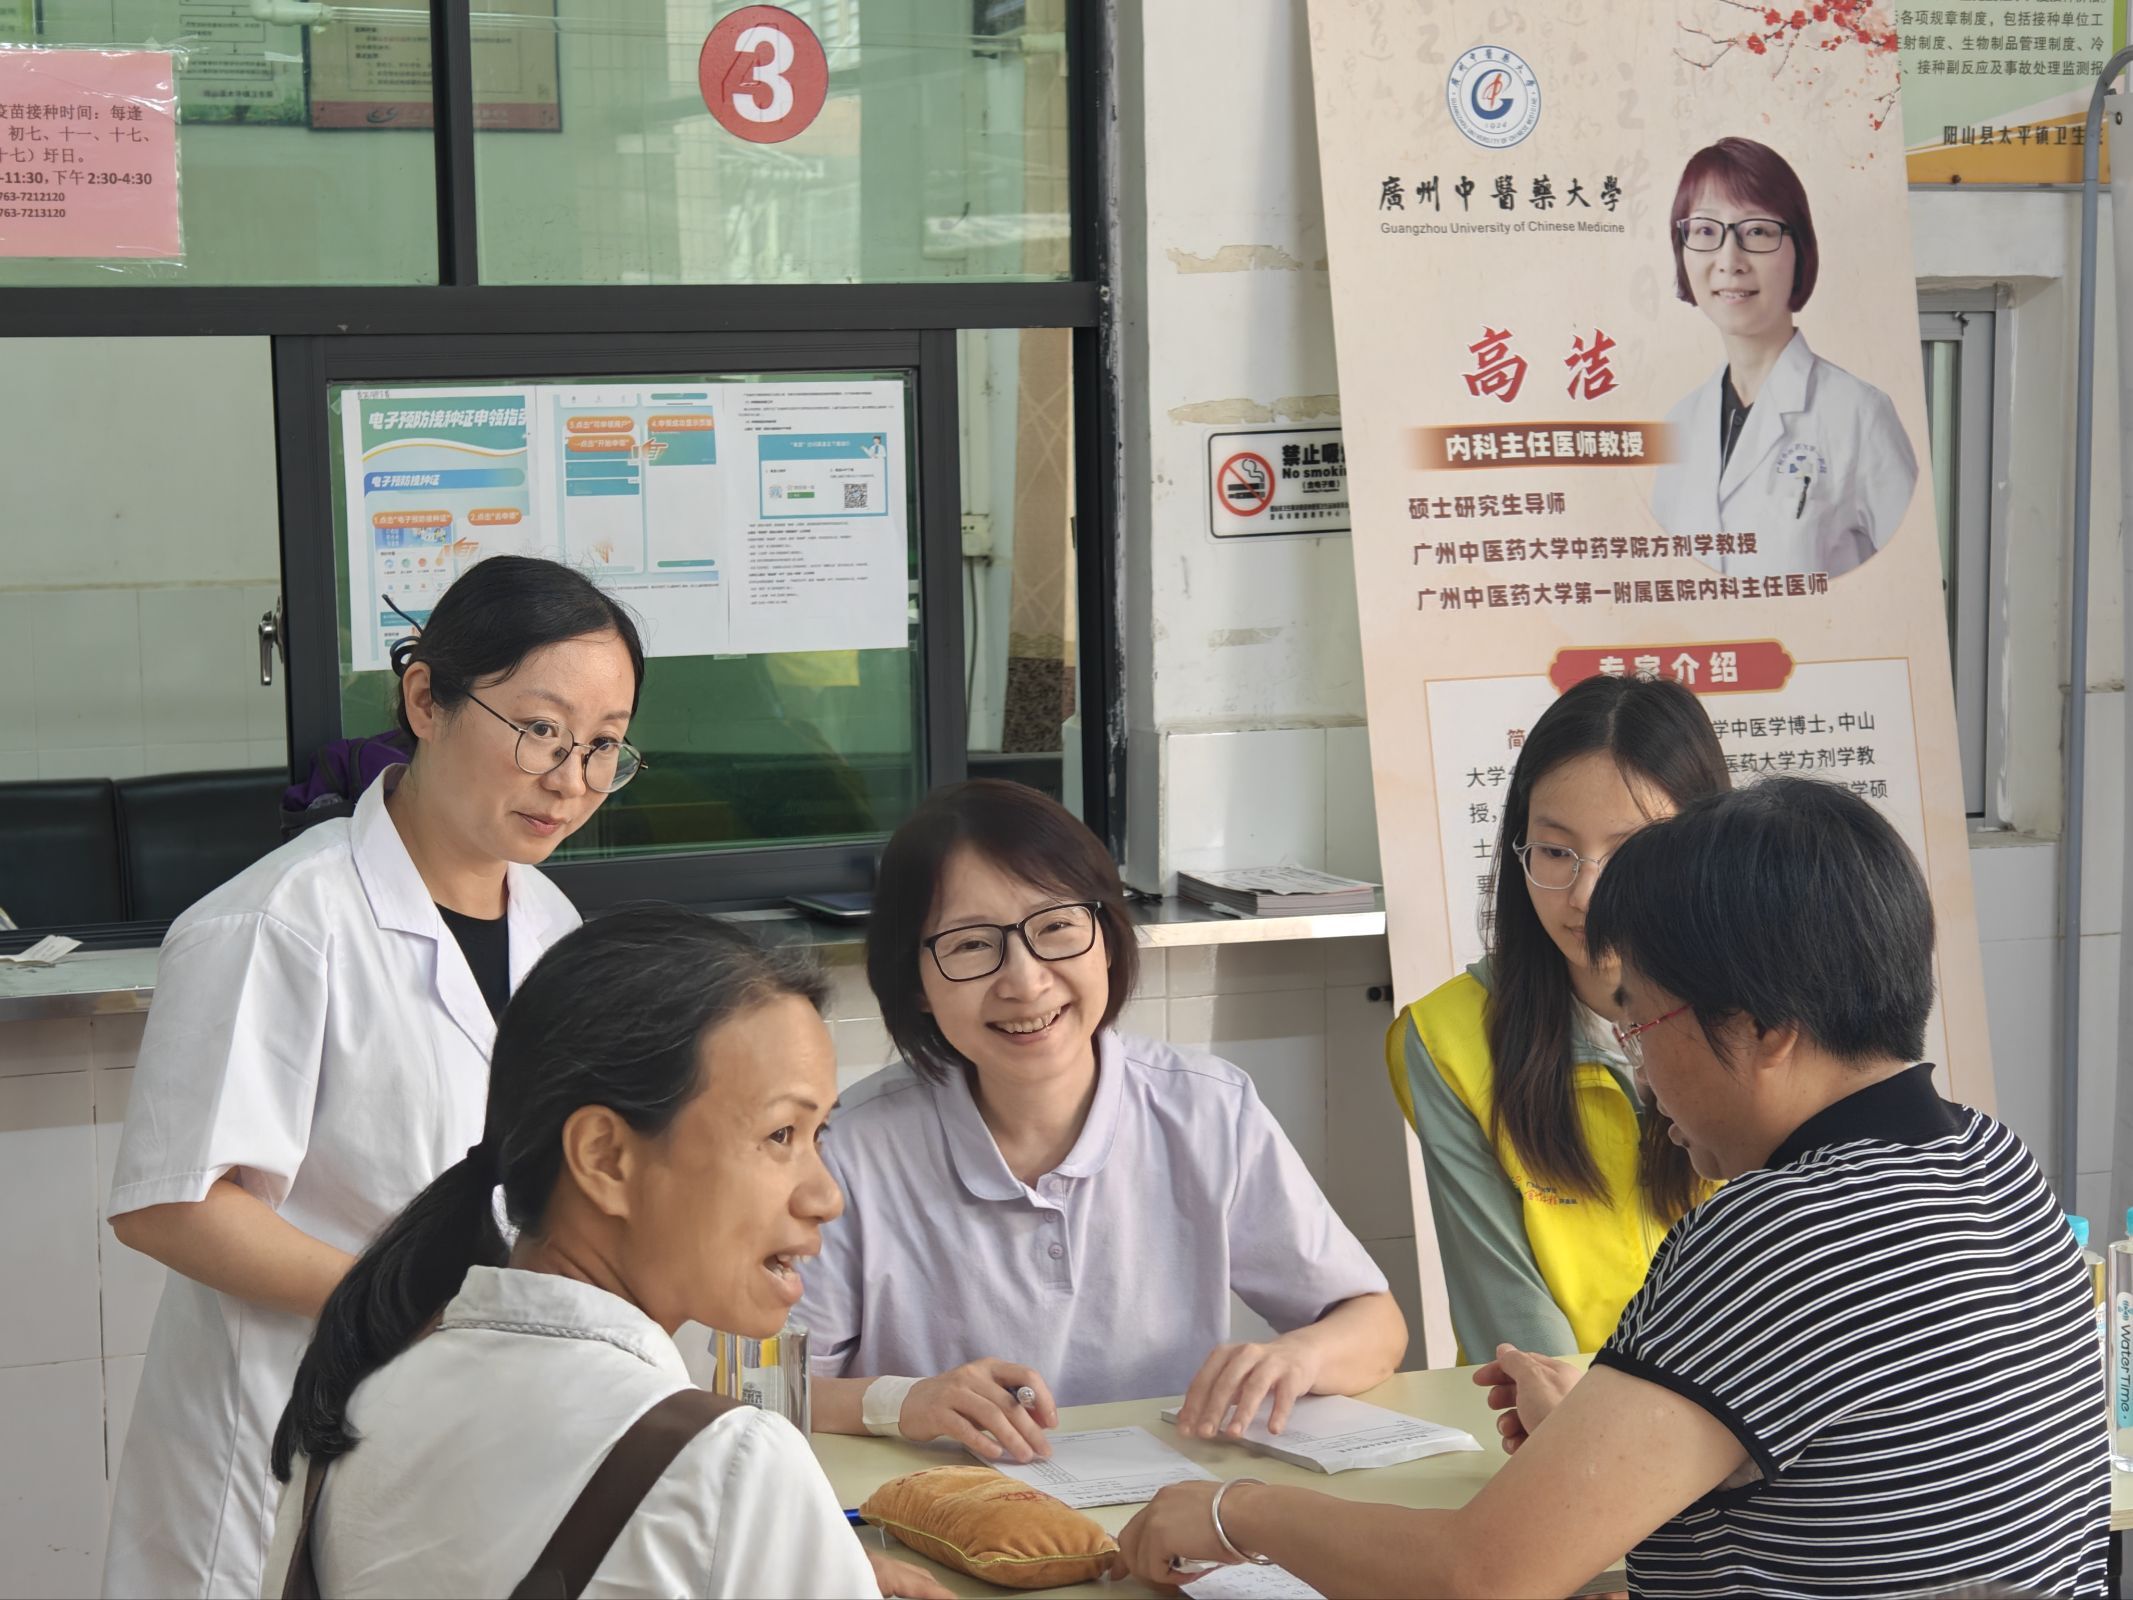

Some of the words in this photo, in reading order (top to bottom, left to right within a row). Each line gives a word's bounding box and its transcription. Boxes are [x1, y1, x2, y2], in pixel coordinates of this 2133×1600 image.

[1895, 10, 2104, 28] 各项规章制度，包括接种单位工
[732, 26, 794, 123] 3
[1898, 60, 2103, 76] 、接种副反应及事故处理监测报
[1943, 125, 2103, 146] 阳山县太平镇卫生
[1379, 174, 1623, 212] 廣州中醫藥大學
[1380, 222, 1448, 236] Guangzhou
[1450, 222, 1511, 235] University
[1514, 221, 1525, 232] of
[1528, 220, 1576, 232] Chinese
[1578, 221, 1625, 233] Medicine
[1461, 324, 1621, 403] 高洁
[1282, 443, 1345, 467] 禁止吸
[1445, 430, 1645, 462] 内科主任医师教授
[1282, 468, 1300, 479] No
[1408, 492, 1567, 520] 硕士研究生导师
[1412, 532, 1759, 566] 广州中医药大学中药学院方剂学教授
[1416, 572, 1829, 611] 广州中医药大学第一附属医院内科主任医师
[1466, 765, 1516, 789] 大学
[1469, 802, 1507, 824] 授，
[1838, 779, 1888, 800] 学硕
